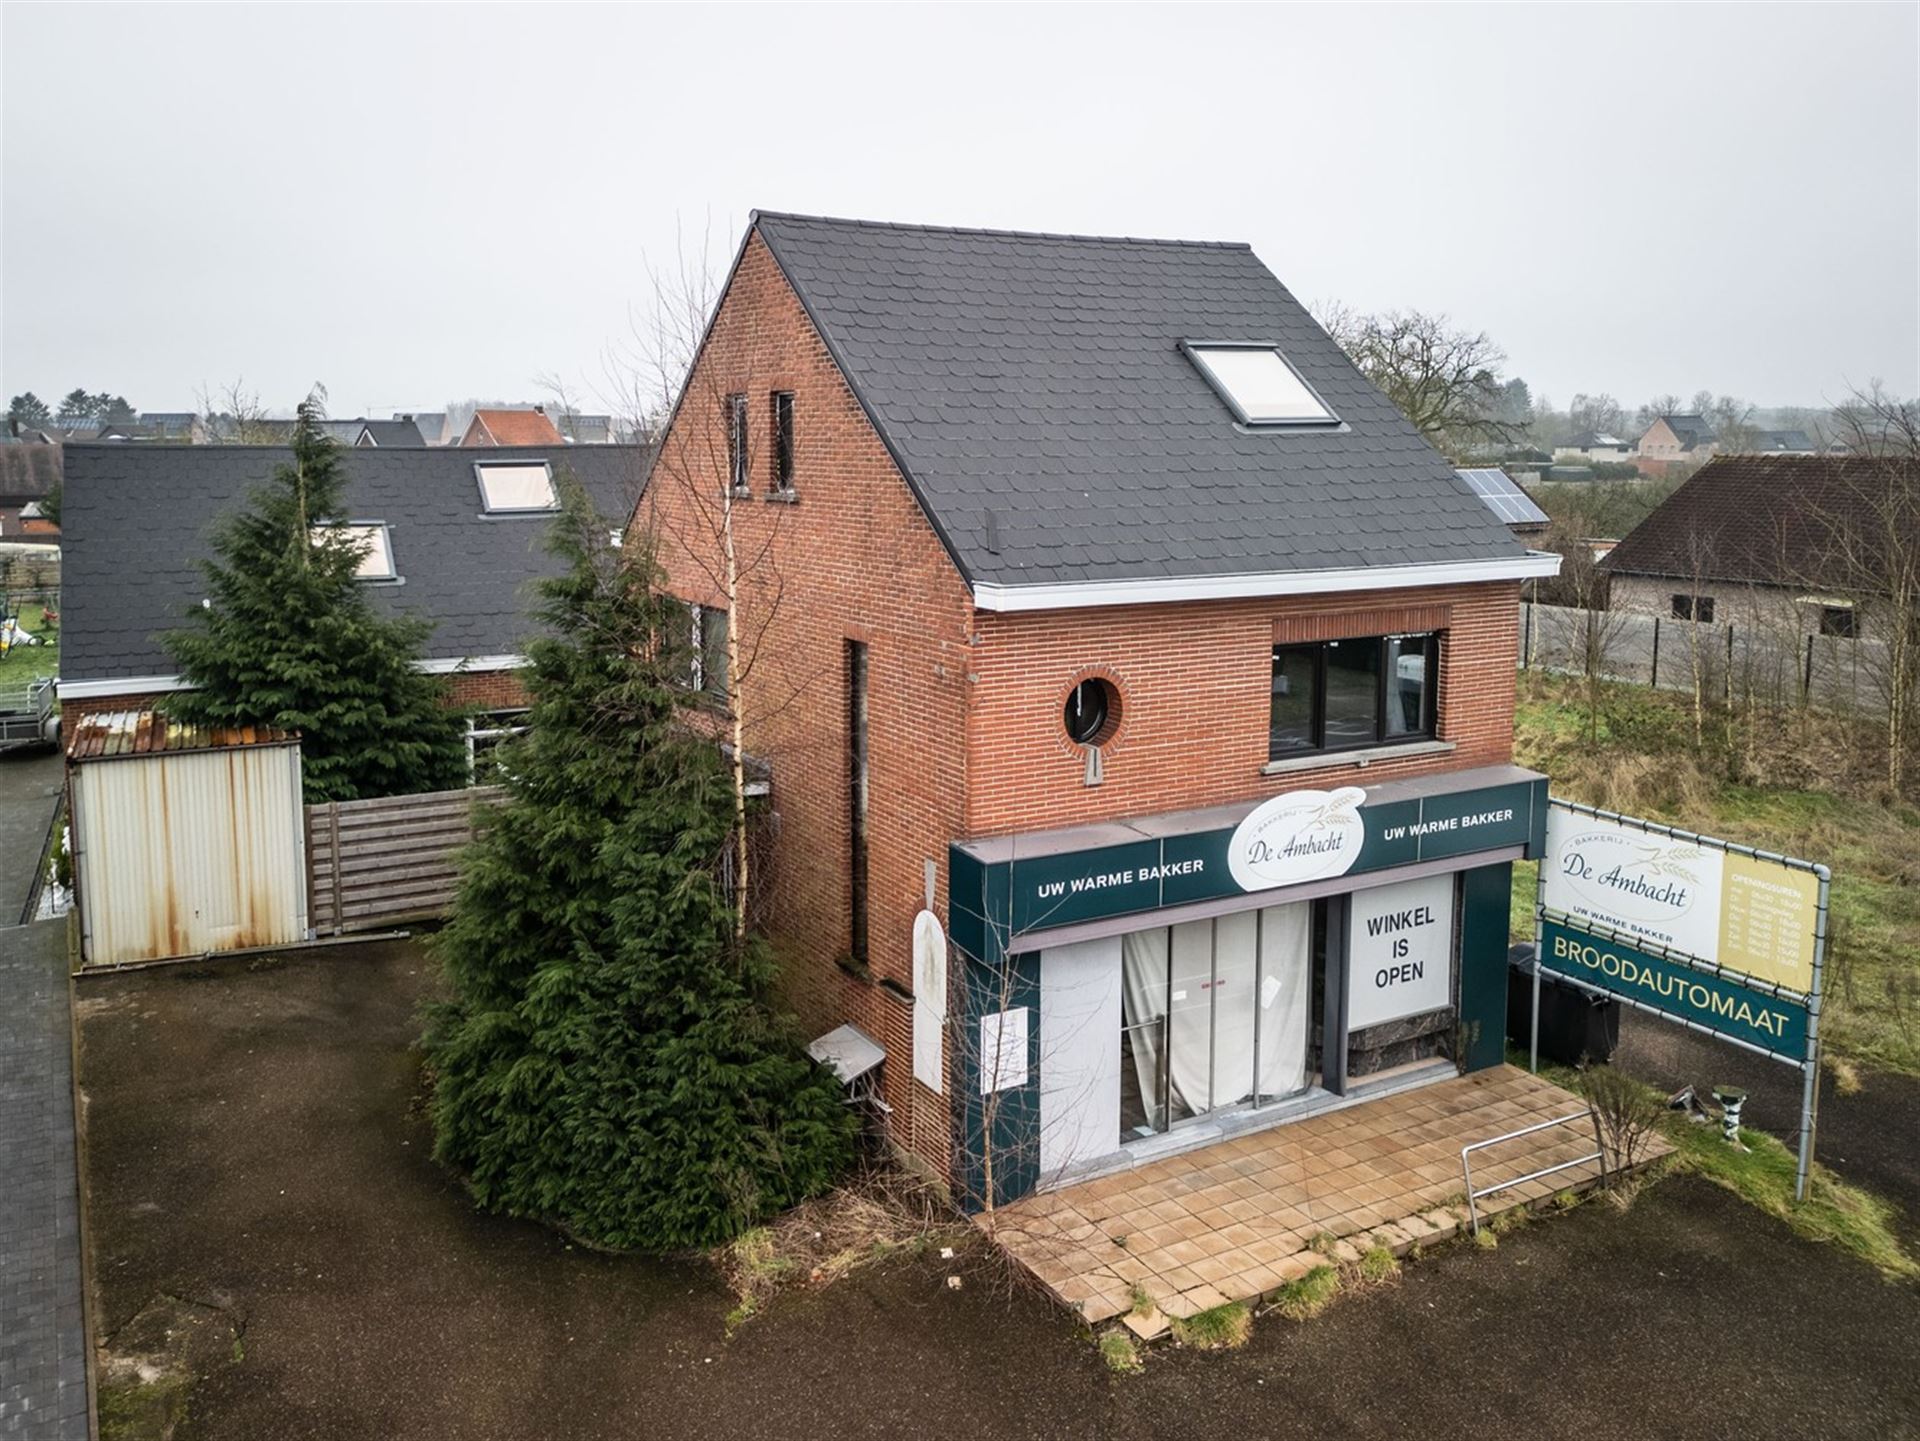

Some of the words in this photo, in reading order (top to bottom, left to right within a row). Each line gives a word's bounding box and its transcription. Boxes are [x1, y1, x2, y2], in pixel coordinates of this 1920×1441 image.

[1384, 827, 1405, 840] UW
[1409, 817, 1458, 836] WARME
[1462, 809, 1513, 828] BAKKER
[1248, 840, 1273, 865] De
[1277, 831, 1343, 860] Ambacht
[1038, 882, 1065, 898] UW
[1071, 870, 1133, 892] WARME
[1139, 859, 1204, 881] BAKKER
[1563, 852, 1593, 880] De
[1598, 864, 1687, 908] Ambacht
[1367, 905, 1436, 937] WINKEL
[1573, 905, 1589, 916] UW
[1591, 911, 1627, 930] WARME
[1630, 923, 1673, 943] BAKKER
[1392, 938, 1409, 959] IS
[1375, 960, 1424, 989] OPEN
[1554, 935, 1790, 1038] BROODAUTOMAAT
